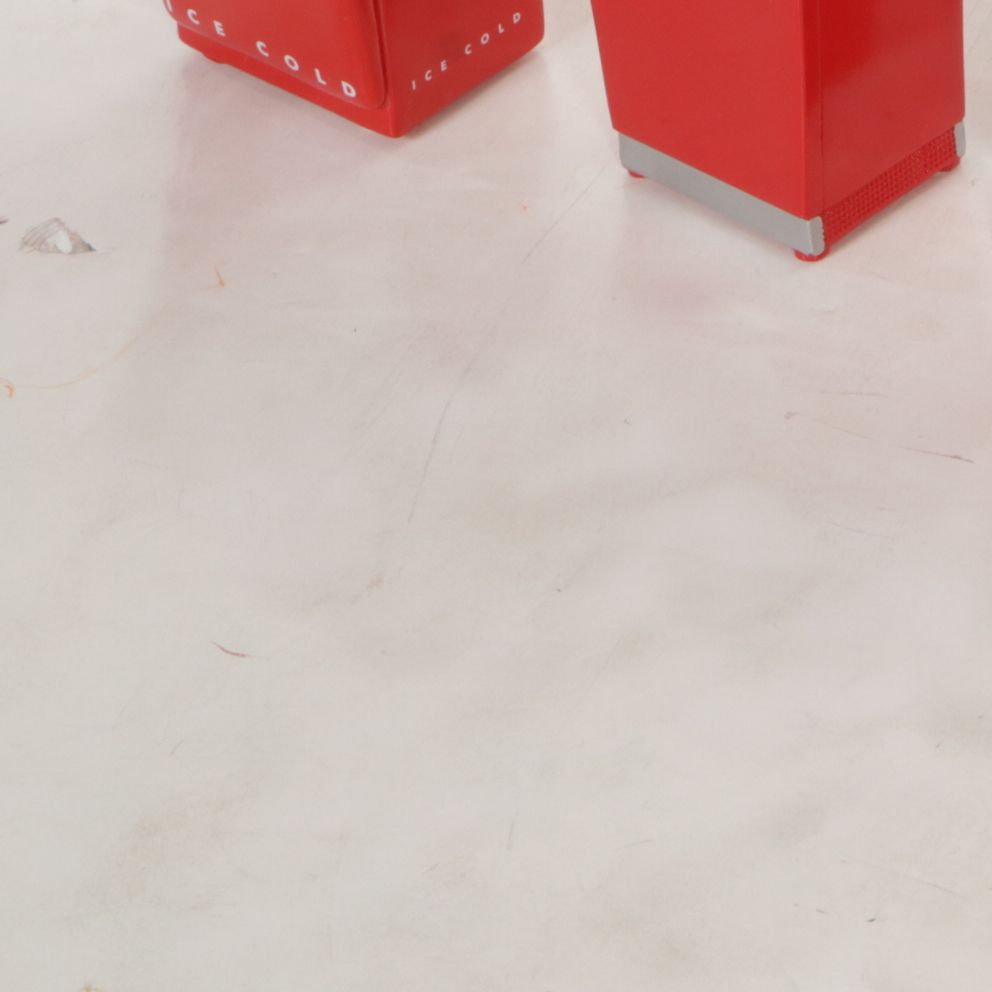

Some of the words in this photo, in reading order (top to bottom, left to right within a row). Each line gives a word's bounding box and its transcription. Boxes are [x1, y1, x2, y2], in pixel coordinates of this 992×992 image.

[256, 40, 357, 98] COLD
[411, 59, 448, 91] ICE
[464, 11, 522, 56] COLD
